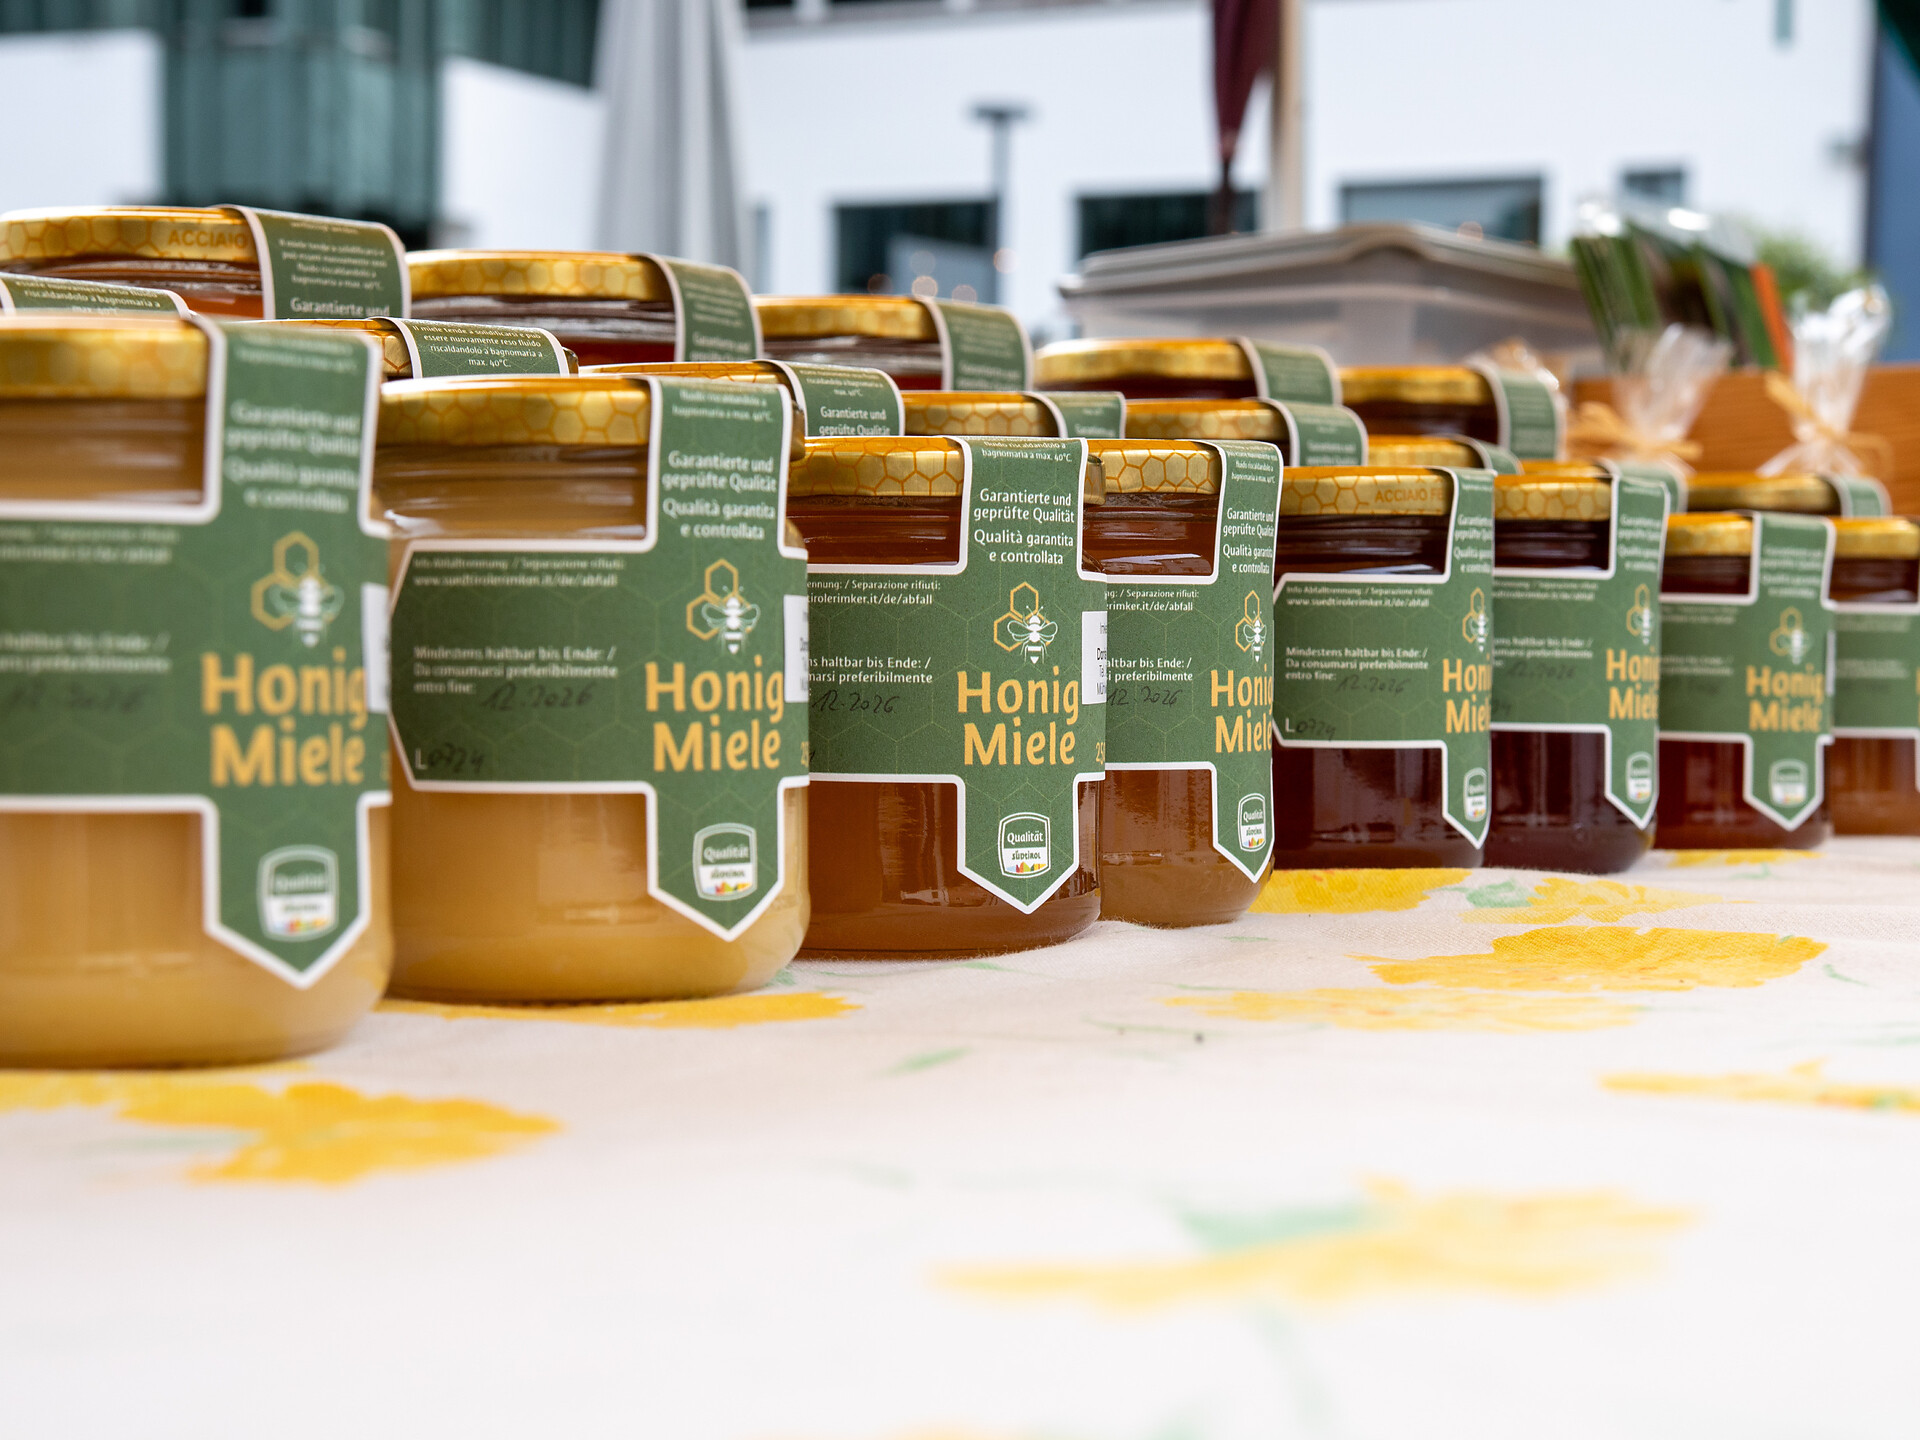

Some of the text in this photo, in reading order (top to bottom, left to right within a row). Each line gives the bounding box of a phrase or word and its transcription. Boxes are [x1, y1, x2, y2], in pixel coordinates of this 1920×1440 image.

[167, 229, 248, 249] ACCIAIO
[450, 336, 499, 345] nuovamente
[430, 344, 482, 354] riscaldandolo
[490, 347, 537, 358] bagnomaria
[468, 358, 512, 368] max. 40°C.
[820, 406, 887, 421] Garantierte und
[819, 423, 890, 436] geprüfte Qualität
[668, 450, 774, 473] Garantierte und
[982, 448, 1029, 459] bagnomaria
[1036, 452, 1053, 460] max.
[1054, 452, 1073, 462] 40°C.
[661, 470, 777, 494] geprüfte Qualität
[980, 488, 1072, 506] Garantierte und
[1374, 487, 1428, 503] ACCIAIO
[662, 498, 776, 521] Qualità garantita
[973, 506, 1075, 524] geprüfte Qualität
[1227, 507, 1274, 522] Garantierte und
[680, 521, 765, 540] e controllata
[974, 529, 1074, 547] Qualità garantita
[1223, 523, 1255, 538] geprüfte
[989, 550, 1064, 565] e controllata
[1222, 544, 1252, 558] Qualità
[1232, 562, 1270, 575] e controllata
[807, 579, 941, 592] ennung: / Separazione rifiuti:
[807, 593, 933, 605] irolerimker.it/de/abfall
[1120, 589, 1125, 597] /
[1126, 590, 1175, 600] Separazione
[1176, 590, 1200, 598] rifiuti:
[1107, 601, 1193, 611] rimker.it/de/abfall
[1286, 647, 1429, 659] Mindestens haltbar bis Ende: /
[821, 656, 864, 668] haltbar
[866, 656, 884, 668] bis
[887, 657, 921, 669] Ende:
[924, 657, 932, 670] /
[1107, 657, 1192, 669] altbar bis Ende: /
[1285, 658, 1429, 671] Da consumarsi preferibilmente
[839, 671, 933, 685] preferibilmente
[1114, 670, 1193, 684] preferibilmente
[1285, 671, 1337, 681] entro fine:
[1443, 653, 1492, 692] Honi
[202, 646, 368, 730] Honig
[645, 655, 784, 723] Honig
[957, 666, 1079, 725] Honig
[653, 714, 782, 772] Miele
[964, 717, 1076, 766] Miele
[210, 715, 366, 787] Miele
[1007, 831, 1044, 845] Qualität
[703, 844, 750, 864] Qualität
